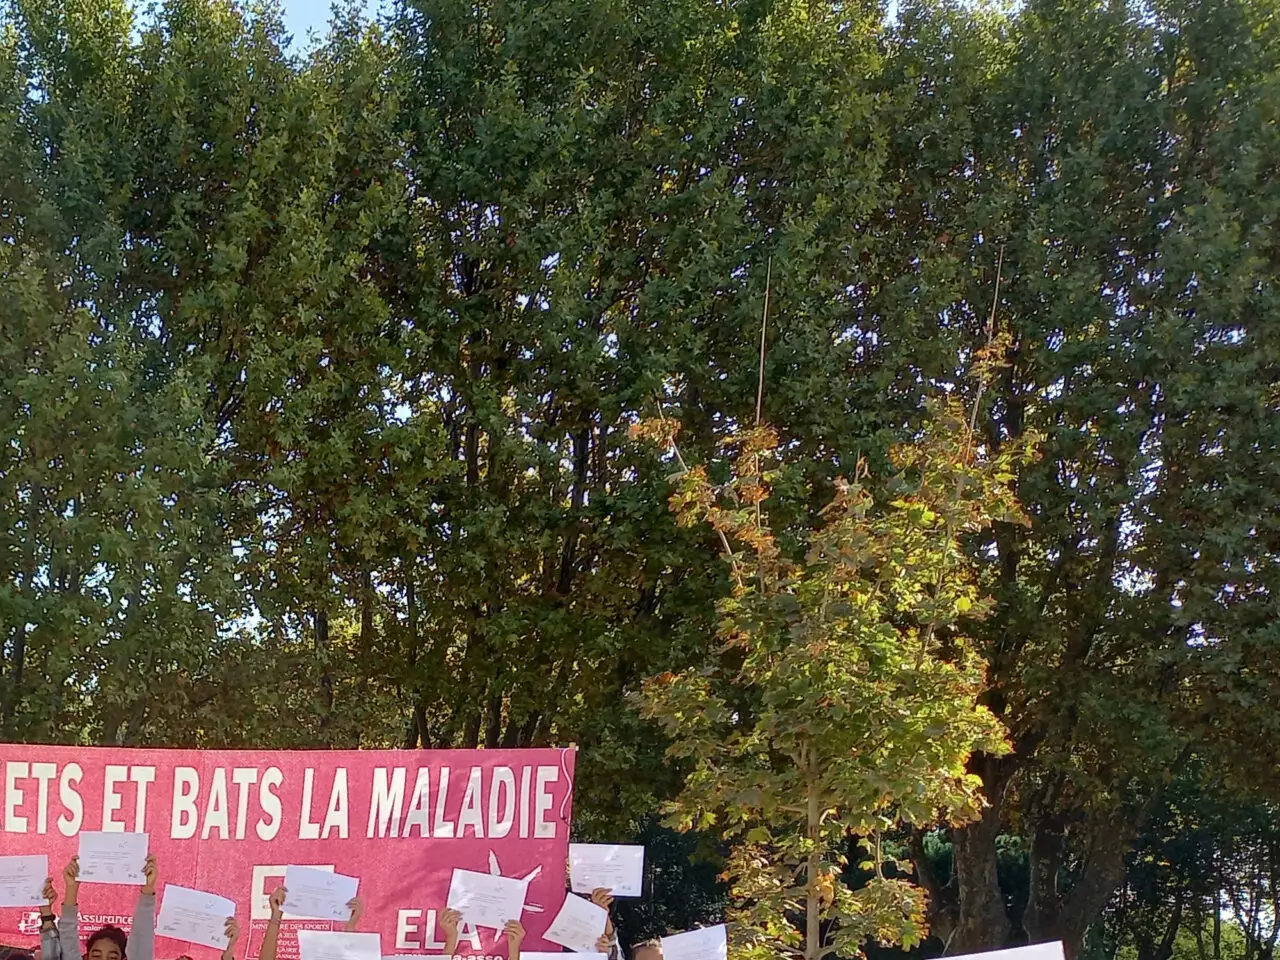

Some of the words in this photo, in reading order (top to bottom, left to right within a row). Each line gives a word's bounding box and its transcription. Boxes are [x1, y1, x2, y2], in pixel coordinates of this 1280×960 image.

[102, 764, 155, 833] ET
[170, 766, 283, 841] BATS
[298, 767, 349, 840] LA
[366, 765, 559, 839] MALADIE
